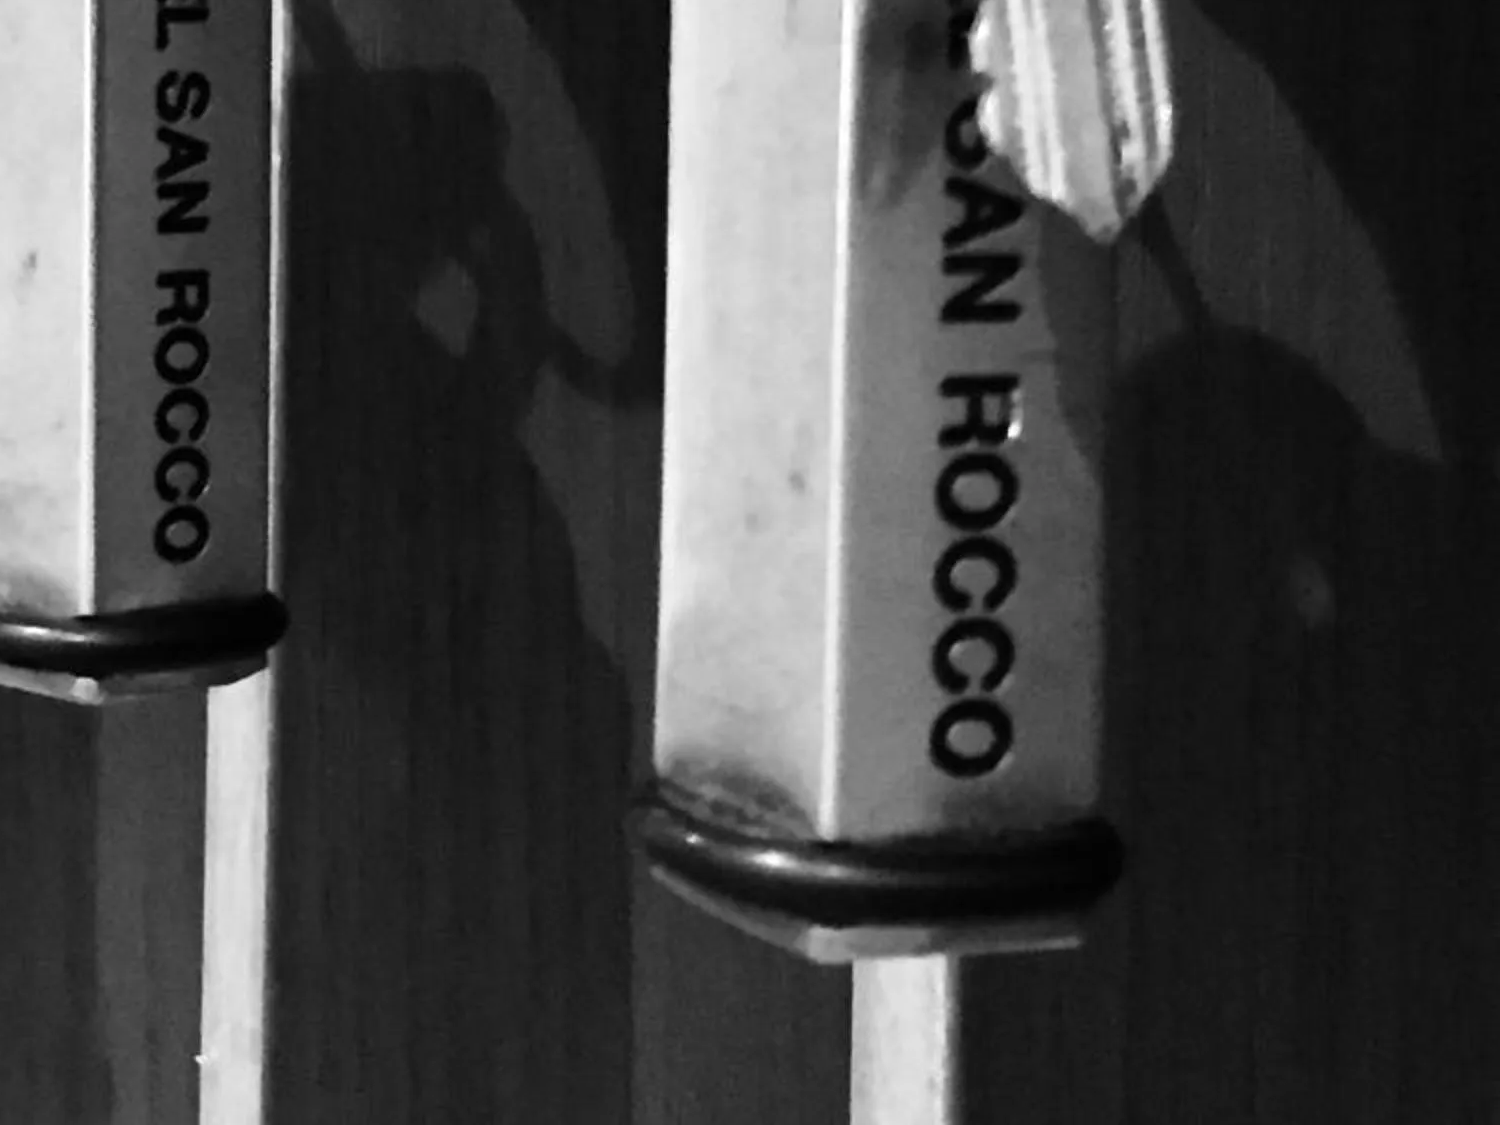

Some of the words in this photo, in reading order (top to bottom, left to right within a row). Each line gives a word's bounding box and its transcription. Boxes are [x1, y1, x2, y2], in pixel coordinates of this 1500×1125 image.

[154, 69, 212, 237] SAN
[153, 268, 212, 566] ROCCO
[928, 373, 1022, 779] ROCCO
